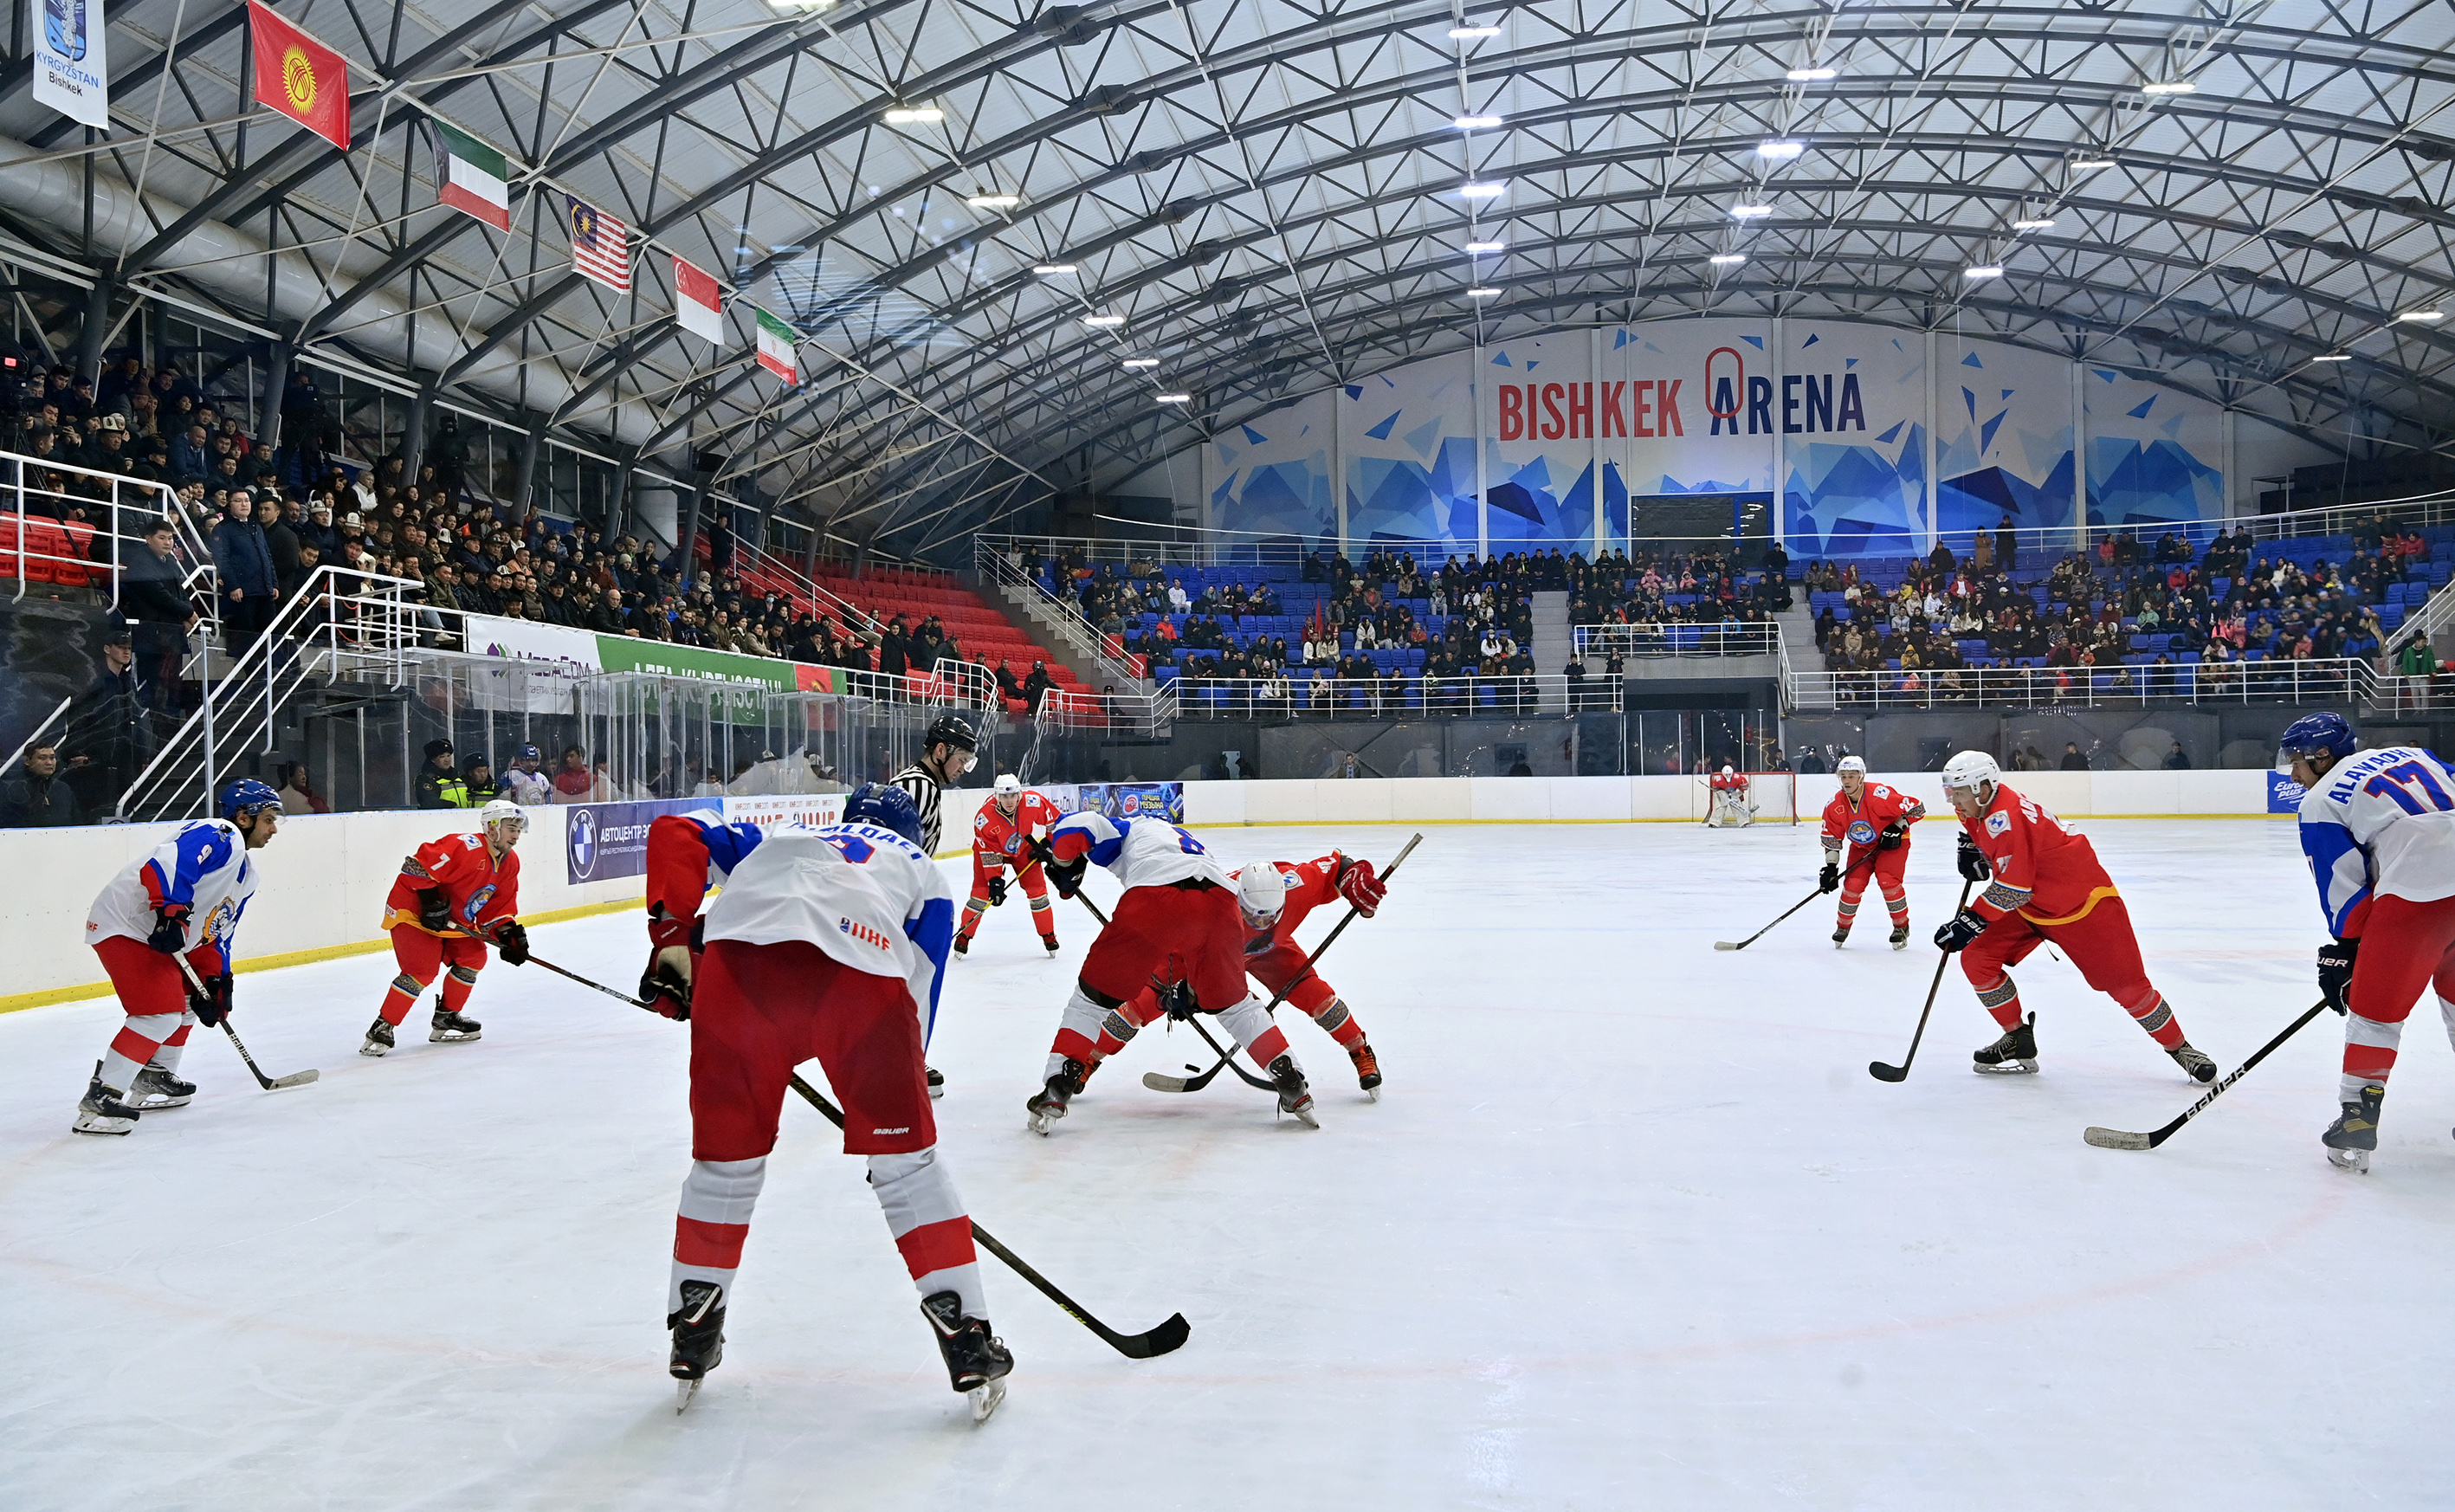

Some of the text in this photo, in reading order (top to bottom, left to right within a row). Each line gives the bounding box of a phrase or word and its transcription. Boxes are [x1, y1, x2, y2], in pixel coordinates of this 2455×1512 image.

[36, 49, 99, 88] KYRGYZSTAN
[48, 71, 83, 96] Bishkek
[1499, 372, 1867, 442] BISHKEK ARENA
[2362, 759, 2455, 816] 17
[600, 824, 641, 843] АВТОЦЕНТР
[197, 843, 213, 866] 9
[430, 853, 451, 871] 7
[851, 922, 890, 951] IIHF
[2186, 1064, 2248, 1112] BAUER
[873, 1127, 909, 1135] BAUER
